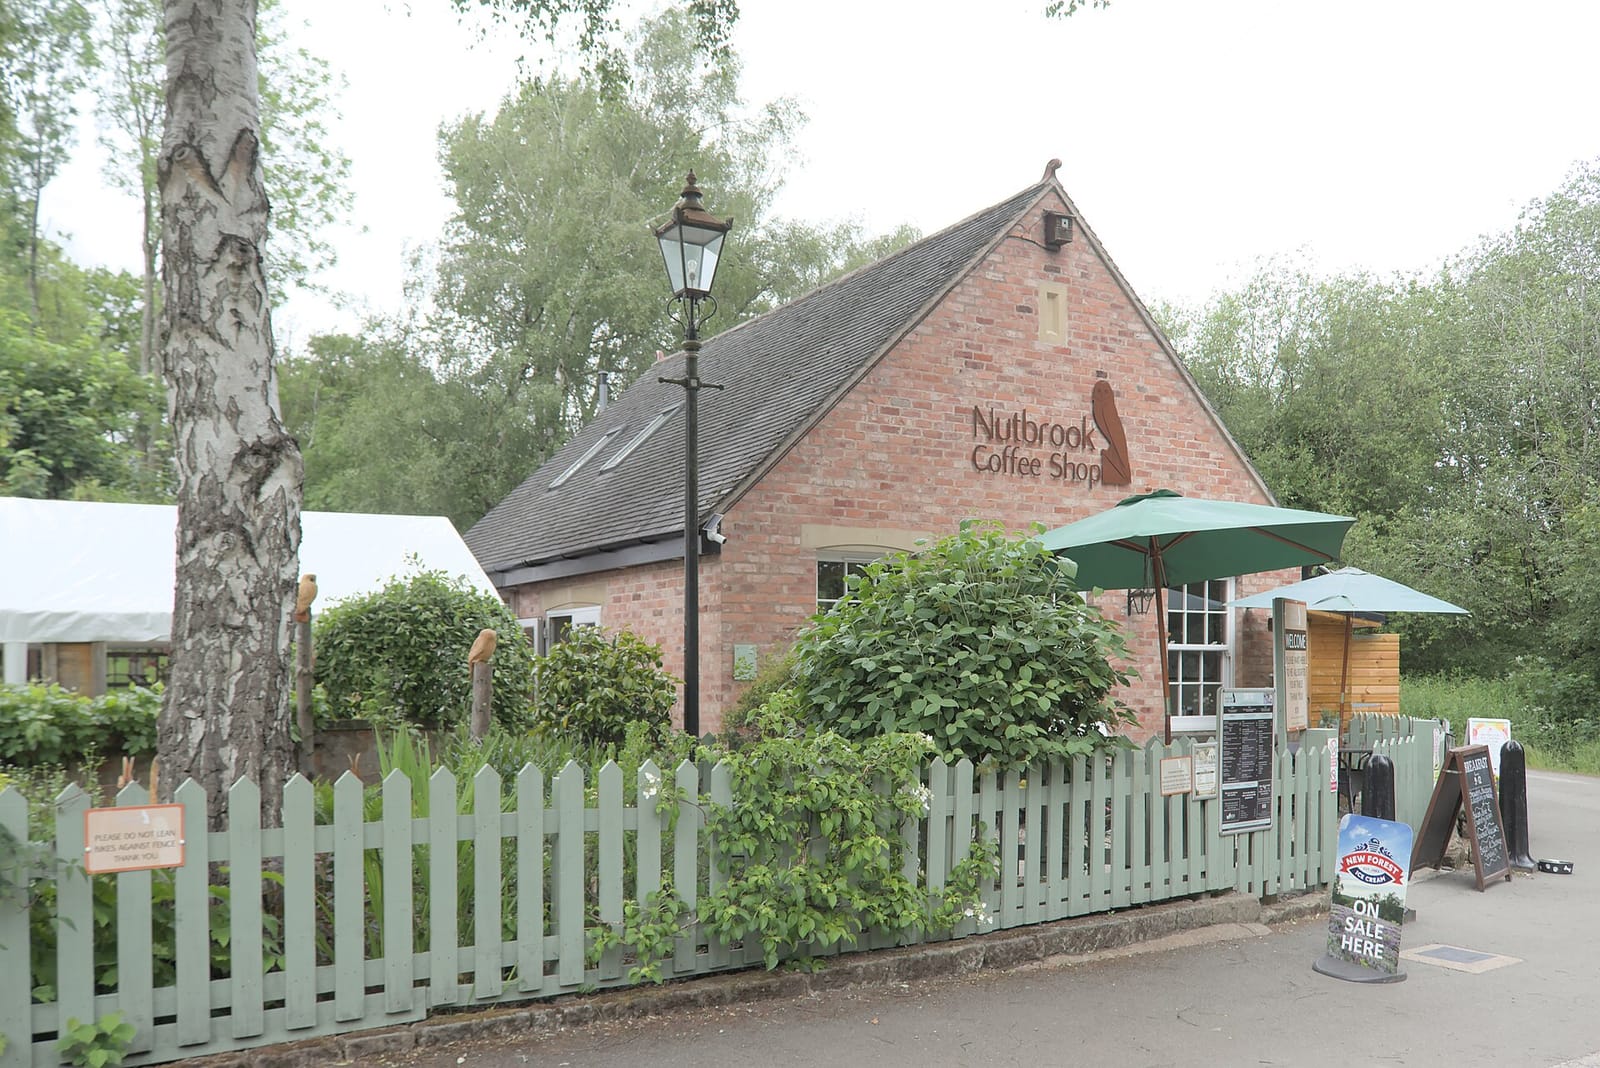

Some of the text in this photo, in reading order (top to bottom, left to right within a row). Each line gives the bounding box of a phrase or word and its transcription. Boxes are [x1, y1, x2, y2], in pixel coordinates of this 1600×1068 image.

[973, 405, 1096, 451] Nutbrook
[973, 445, 1101, 490] Coffee Shop
[1286, 633, 1306, 649] WELCOME
[1464, 757, 1488, 773] BREAKFAST
[95, 829, 176, 841] PLEASE DO NOT LEAN
[95, 840, 176, 853] BIKES AGAINST FENCE
[114, 854, 140, 862] THANK
[1346, 855, 1399, 875] NEW FOREST
[1354, 870, 1365, 880] ICE
[1365, 875, 1386, 883] CREAM
[1353, 899, 1380, 919] ON
[1344, 916, 1385, 940] SALE
[1341, 934, 1385, 960] HERE
